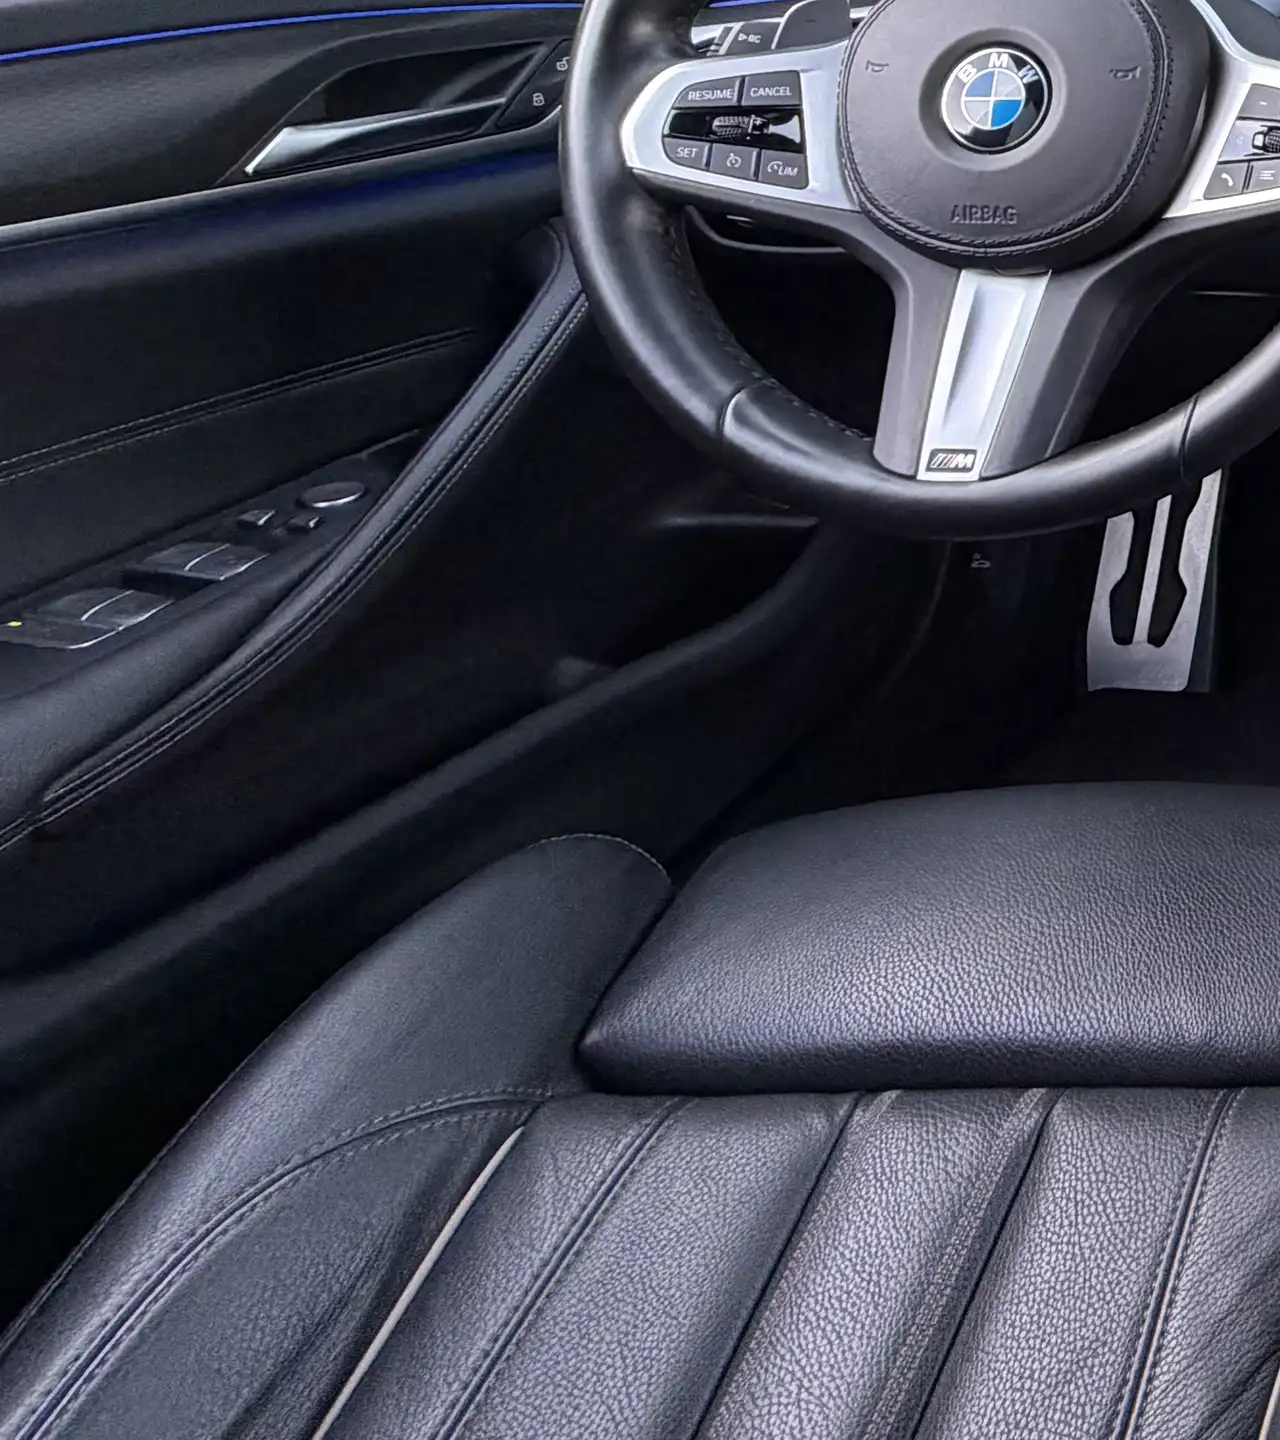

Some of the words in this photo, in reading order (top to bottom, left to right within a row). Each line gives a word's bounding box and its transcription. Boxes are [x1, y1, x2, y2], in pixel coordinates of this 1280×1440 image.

[957, 52, 1040, 84] BMW
[688, 88, 734, 101] RESUME
[750, 86, 792, 98] CANCEL
[676, 147, 698, 158] SET
[778, 166, 798, 177] LIM
[950, 204, 1018, 225] AIRBAG
